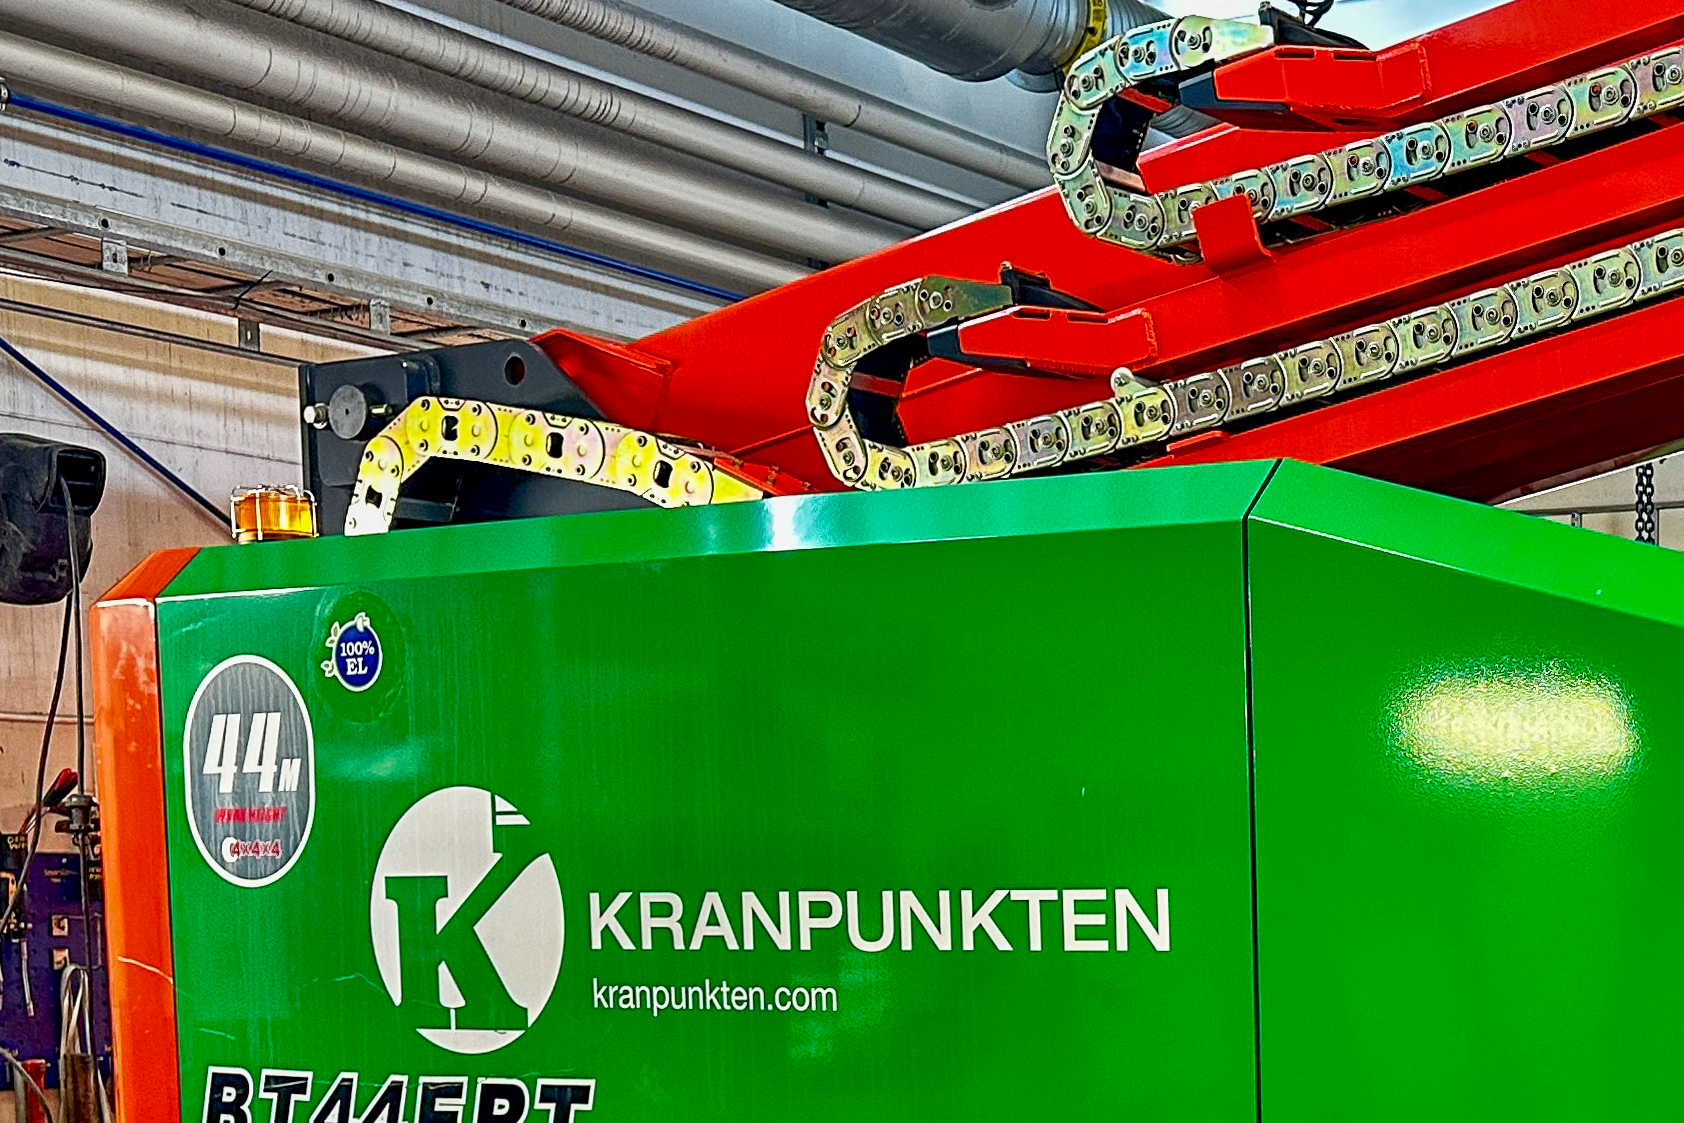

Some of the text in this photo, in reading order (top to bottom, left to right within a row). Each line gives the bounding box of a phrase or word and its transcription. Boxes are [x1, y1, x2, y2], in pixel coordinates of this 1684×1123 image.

[340, 640, 375, 657] 100%
[345, 657, 368, 676] EL
[589, 888, 1171, 952] KRANPUNKTEN
[592, 976, 838, 1017] kranpunkten.com
